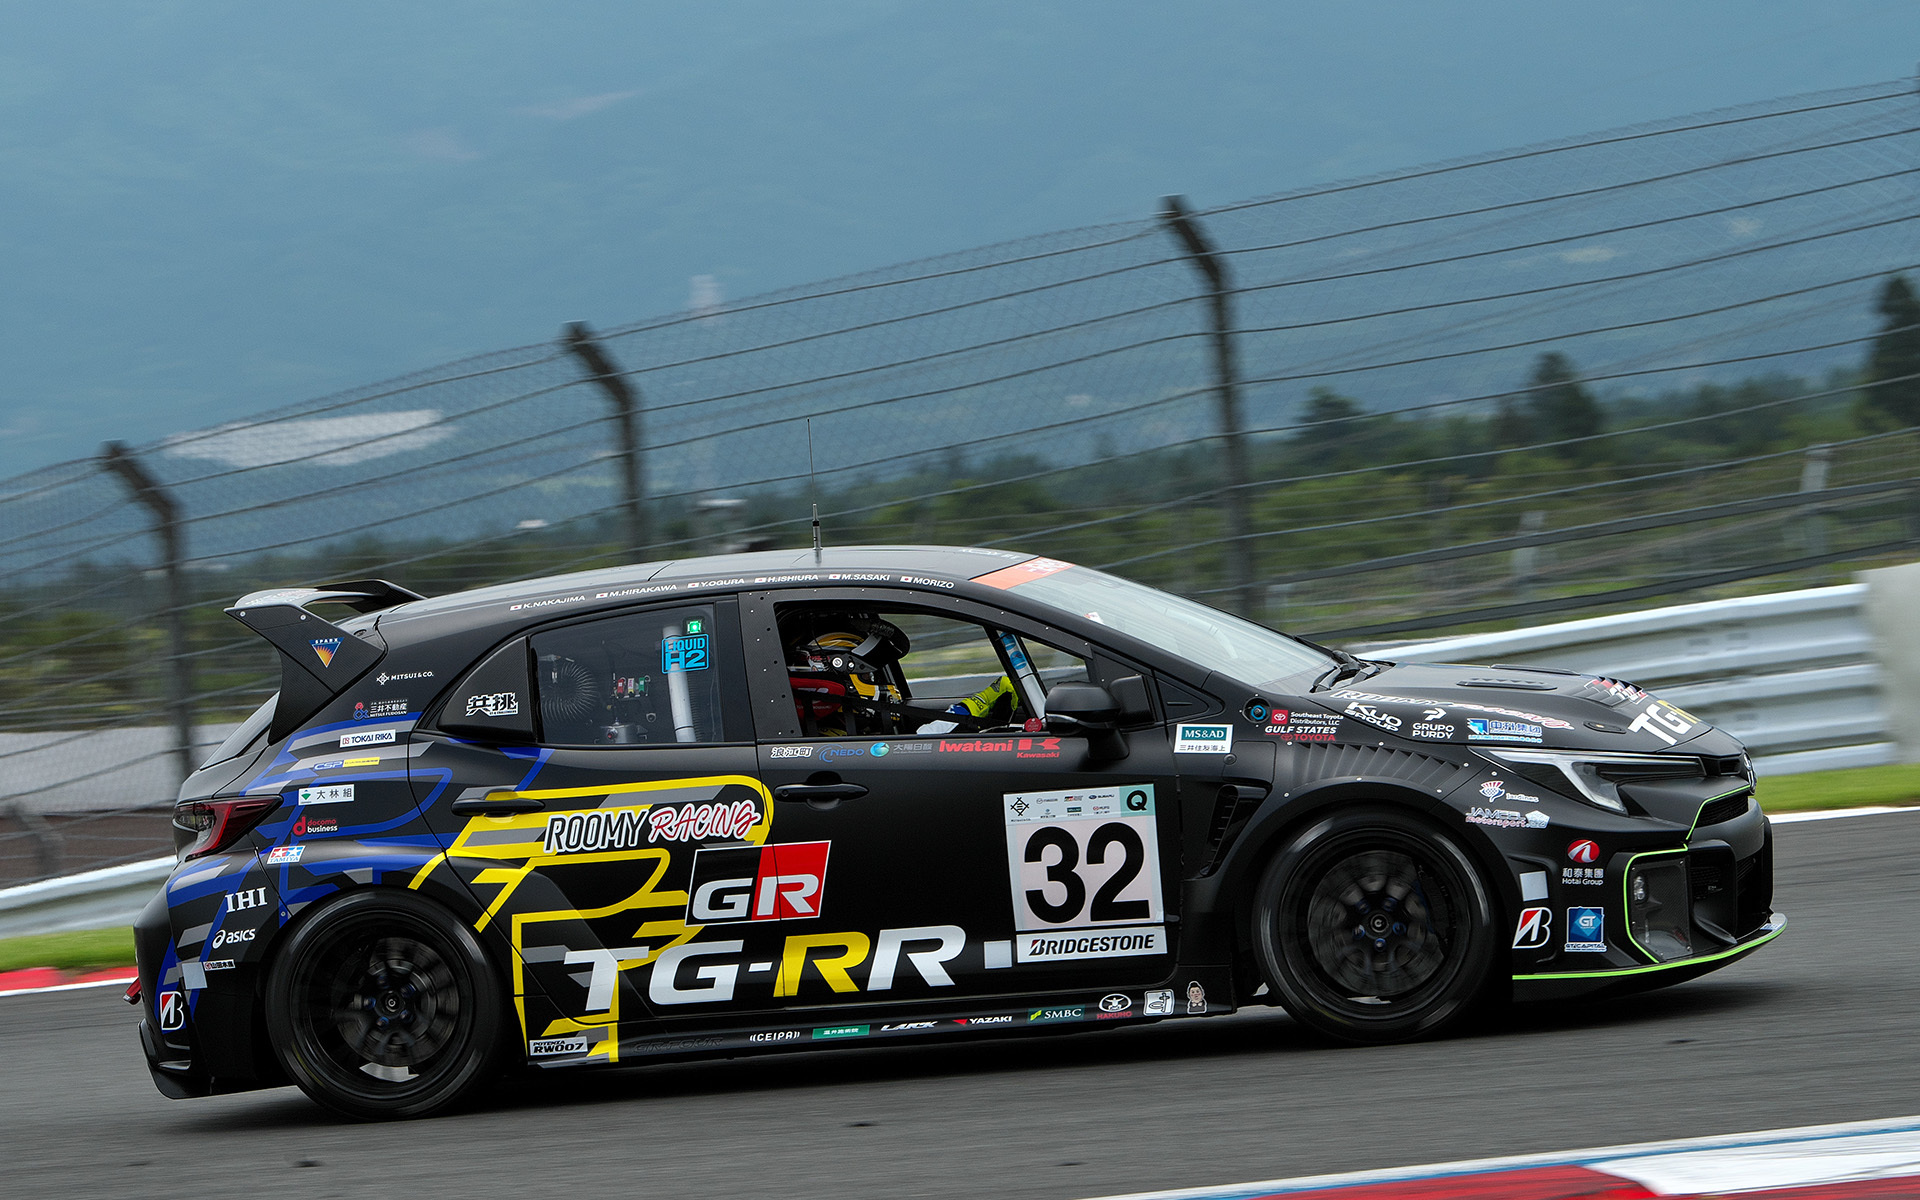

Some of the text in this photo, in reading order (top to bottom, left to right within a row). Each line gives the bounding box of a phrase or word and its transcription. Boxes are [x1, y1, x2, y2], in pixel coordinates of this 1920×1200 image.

[701, 577, 745, 588] Y.OGURA
[767, 574, 819, 584] H.ISHIURA
[841, 573, 890, 582] M.SASAKI
[913, 576, 955, 589] MORIZO
[609, 583, 678, 599] M.HIRAKAWA
[522, 595, 586, 610] K.NAKAJIMA
[665, 638, 706, 652] LIQUID
[665, 650, 706, 670] H2
[1291, 711, 1322, 719] Southeast
[1344, 708, 1399, 732] GROUP
[1347, 702, 1402, 727] KUO
[1264, 726, 1337, 734] GULF STATES
[1413, 723, 1455, 732] GRUPO
[351, 732, 393, 744] TOKAI RIKA
[1185, 729, 1224, 738] MS&AD
[1413, 730, 1454, 739] PURDY
[939, 739, 1013, 752] Iwatani
[771, 747, 813, 758] 浪江町
[314, 761, 342, 769] CSP
[316, 788, 352, 800] 大林組
[1126, 790, 1148, 811] Q
[307, 818, 336, 826] docomo
[545, 801, 761, 852] ROOMY RACING
[307, 825, 338, 833] business
[1024, 822, 1150, 923] 32
[1582, 878, 1604, 886] Group
[224, 887, 267, 913] IHI
[693, 874, 819, 920] GR
[1579, 916, 1596, 927] GT
[226, 928, 256, 943] asics
[1028, 934, 1155, 956] BRIDGESTONE
[1044, 1008, 1082, 1019] SMBC
[1096, 1011, 1132, 1020] HAKUHO
[969, 1015, 1012, 1024] YAZAKI
[533, 1043, 584, 1054] RW007
